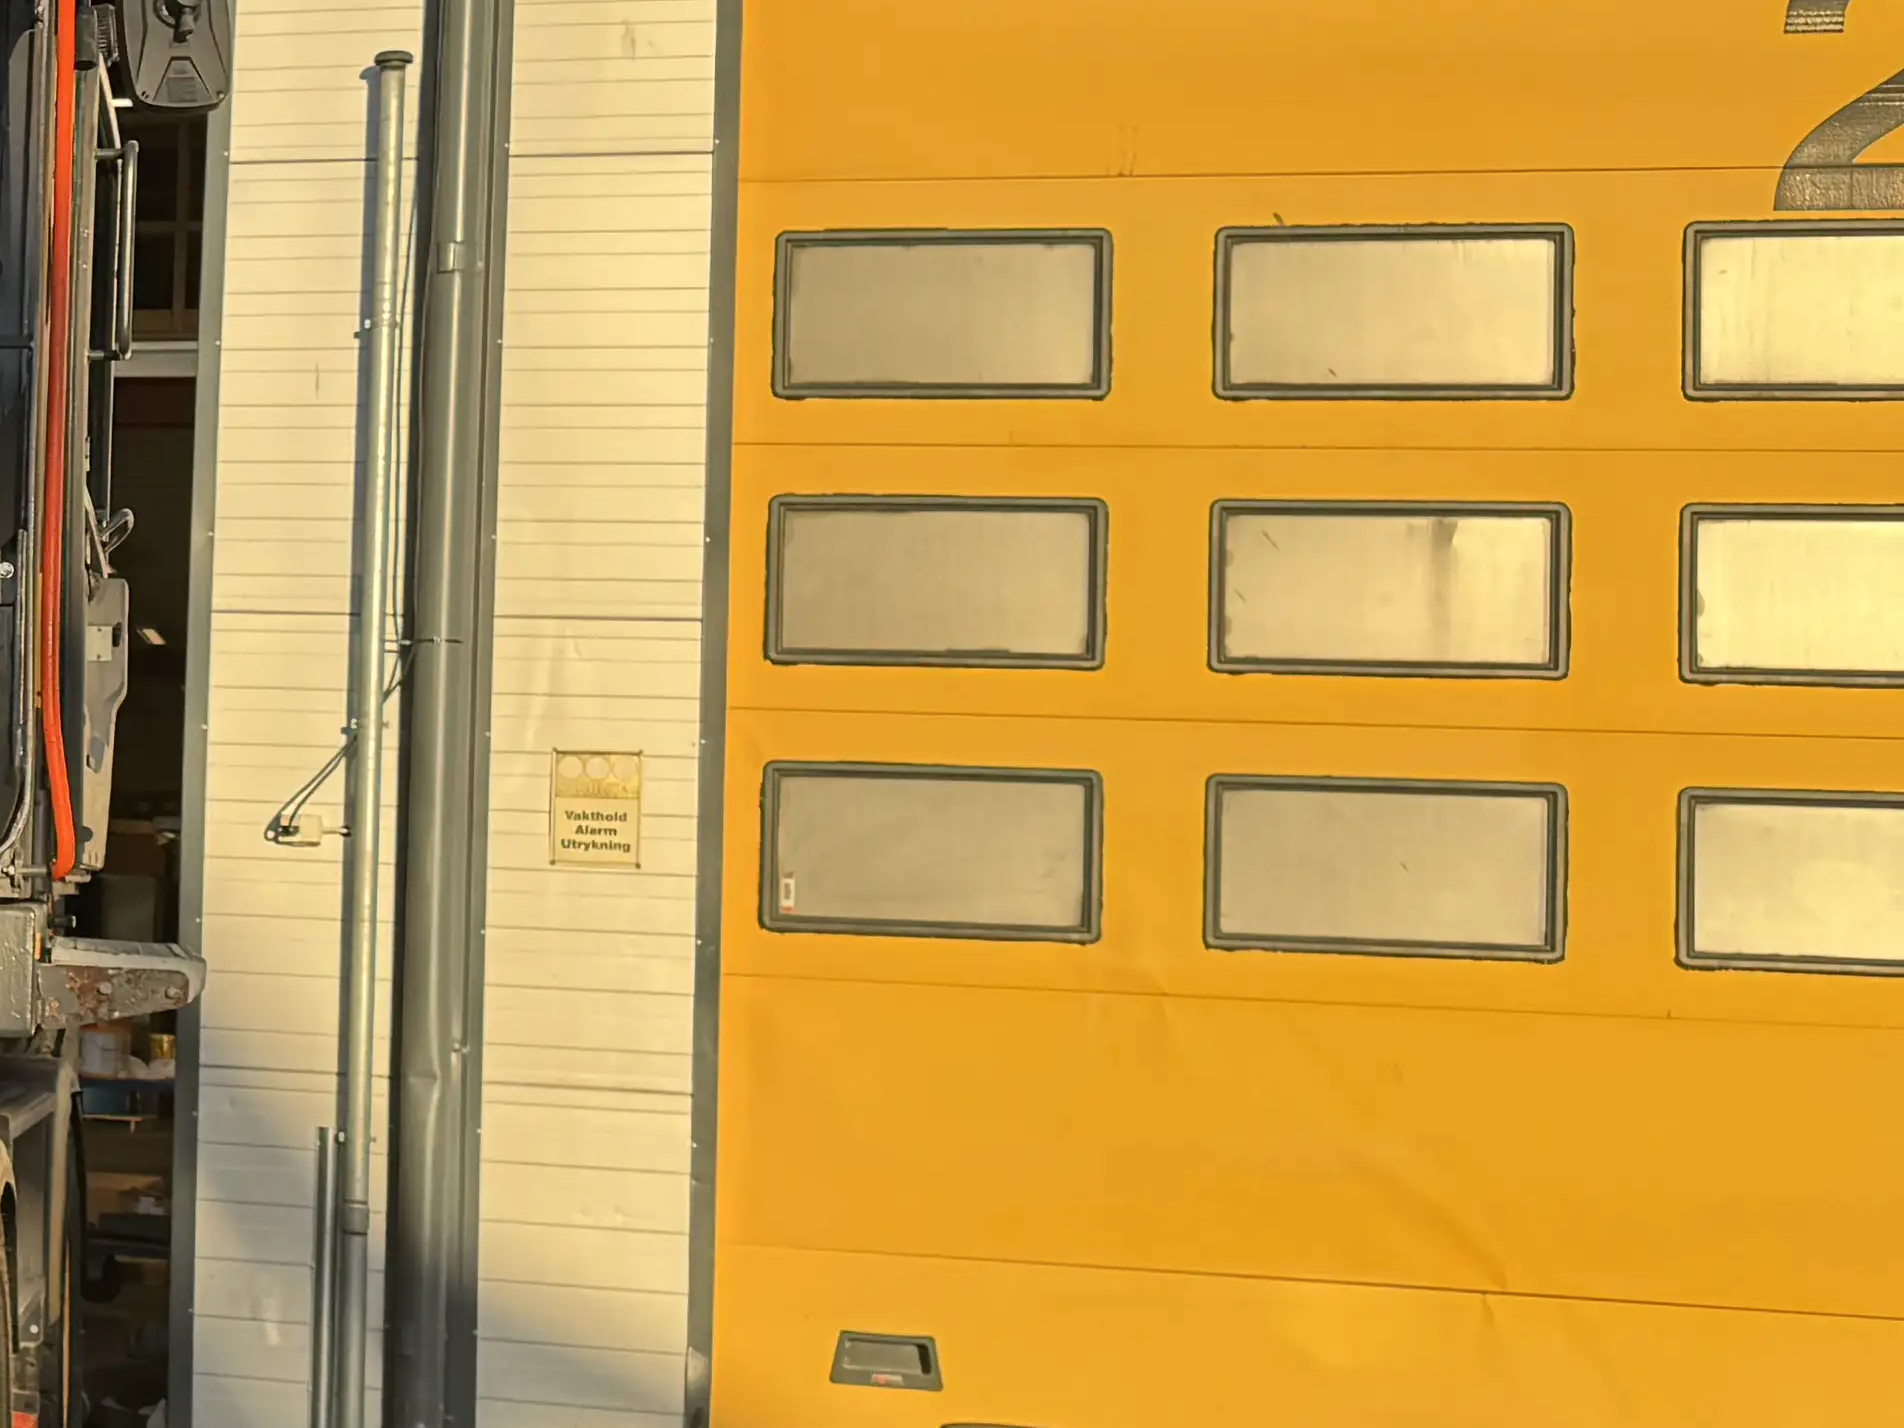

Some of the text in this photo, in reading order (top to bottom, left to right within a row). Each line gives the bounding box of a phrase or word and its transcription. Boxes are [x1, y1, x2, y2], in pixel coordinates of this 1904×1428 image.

[564, 810, 627, 822] Vakthold
[575, 824, 618, 836] Alarm
[560, 838, 631, 853] Utrykning
